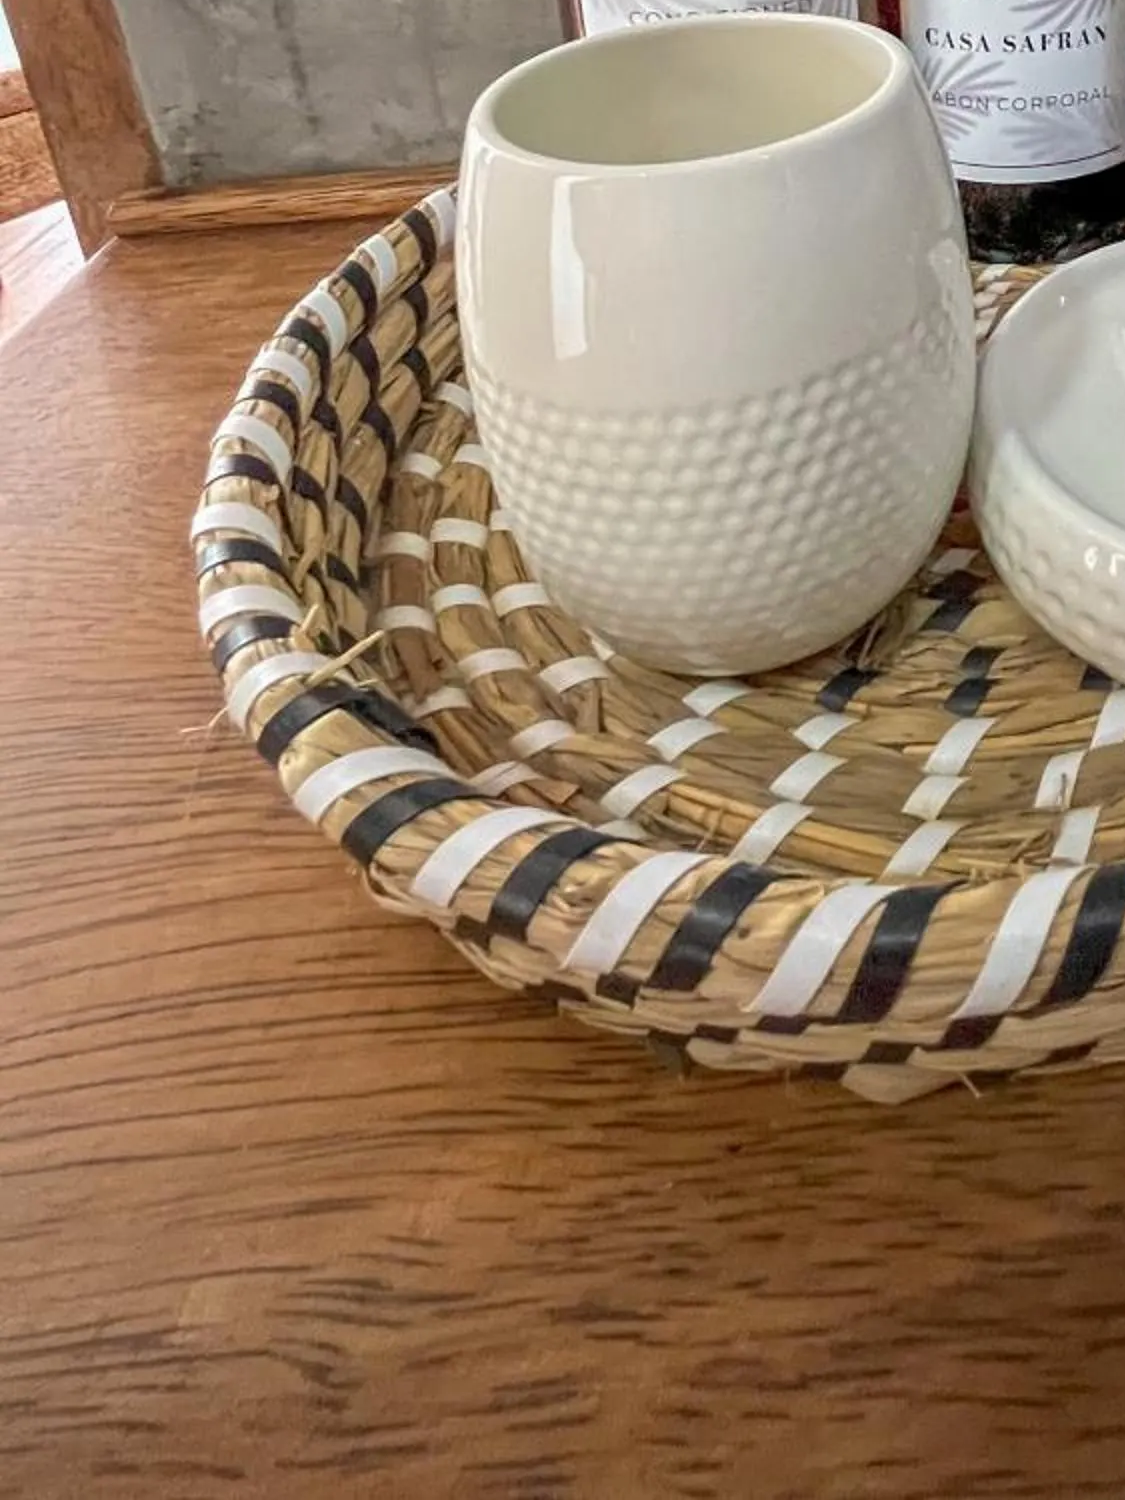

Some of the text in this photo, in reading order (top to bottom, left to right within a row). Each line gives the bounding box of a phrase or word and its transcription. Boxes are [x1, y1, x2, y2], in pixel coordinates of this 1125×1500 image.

[925, 24, 1108, 54] CASA SAFRAN
[997, 86, 1110, 112] CORPORAL
